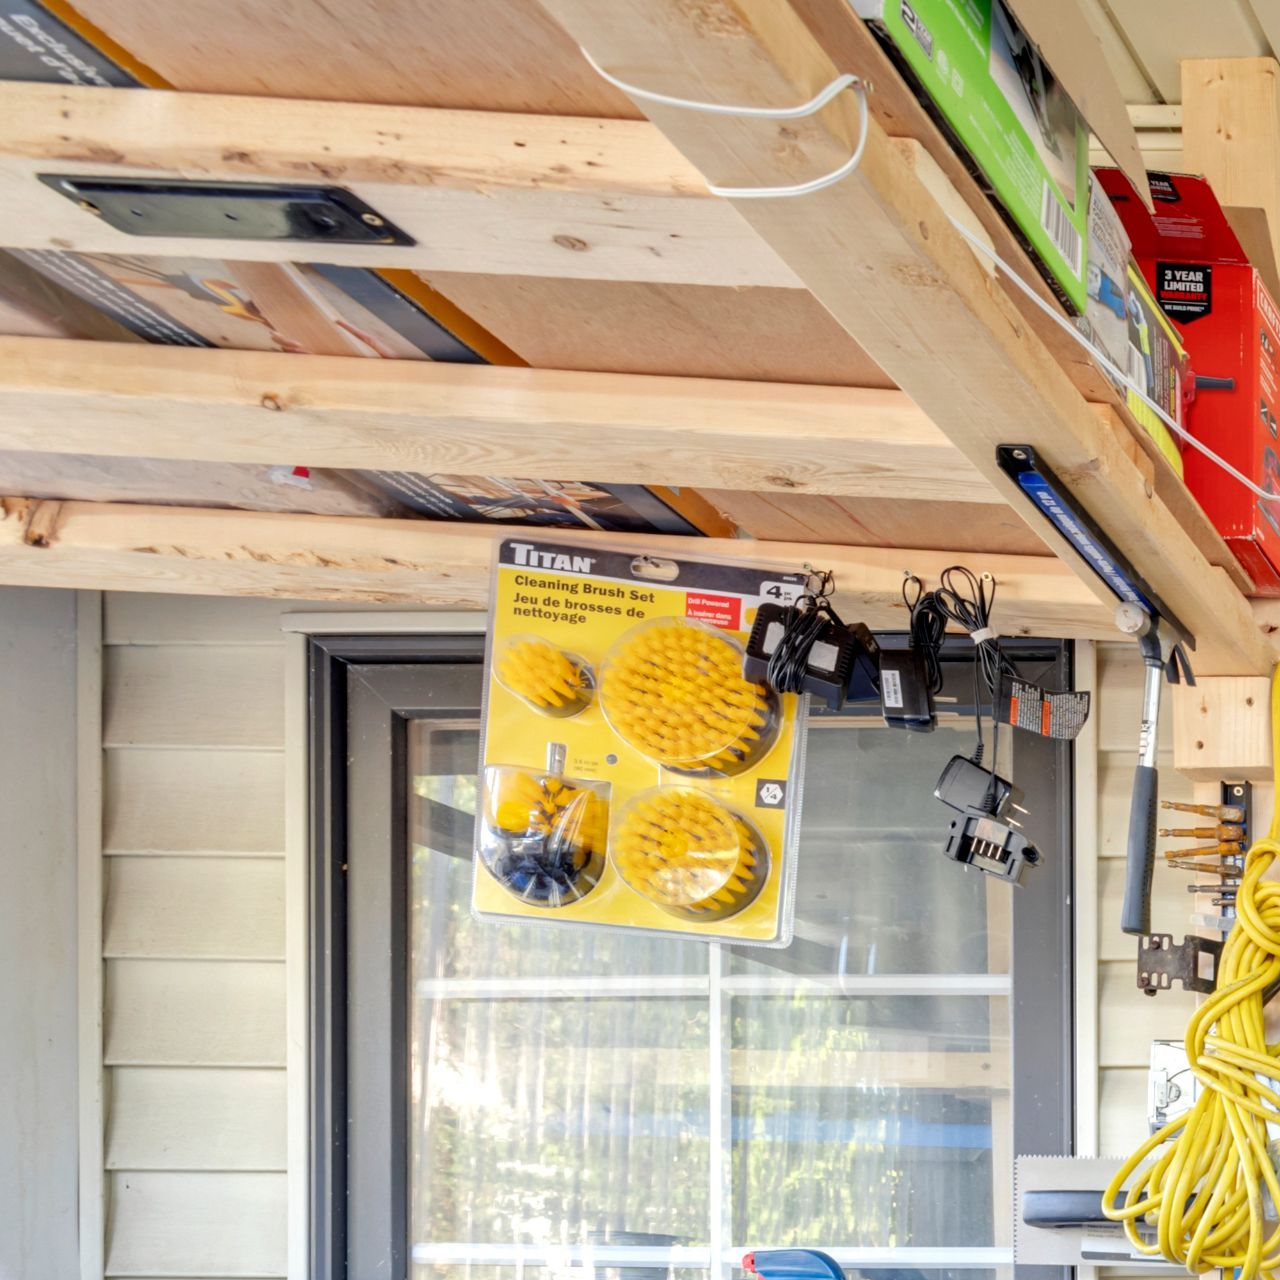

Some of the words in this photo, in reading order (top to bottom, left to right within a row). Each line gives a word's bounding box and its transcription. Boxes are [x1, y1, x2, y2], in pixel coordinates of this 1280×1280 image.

[1165, 270, 1172, 280] 3
[1175, 271, 1203, 282] YEAR
[1164, 281, 1204, 292] LIMITED
[510, 542, 592, 573] TITAN
[515, 575, 578, 594] Cleaning
[583, 584, 625, 598] Brush
[629, 590, 655, 603] Set
[766, 585, 782, 599] 4
[513, 593, 538, 605] Jeu
[542, 597, 560, 608] de
[565, 598, 622, 615] brosses
[626, 607, 645, 618] de
[687, 597, 701, 605] Drill
[702, 599, 730, 608] Powered
[513, 606, 586, 624] nettoyage
